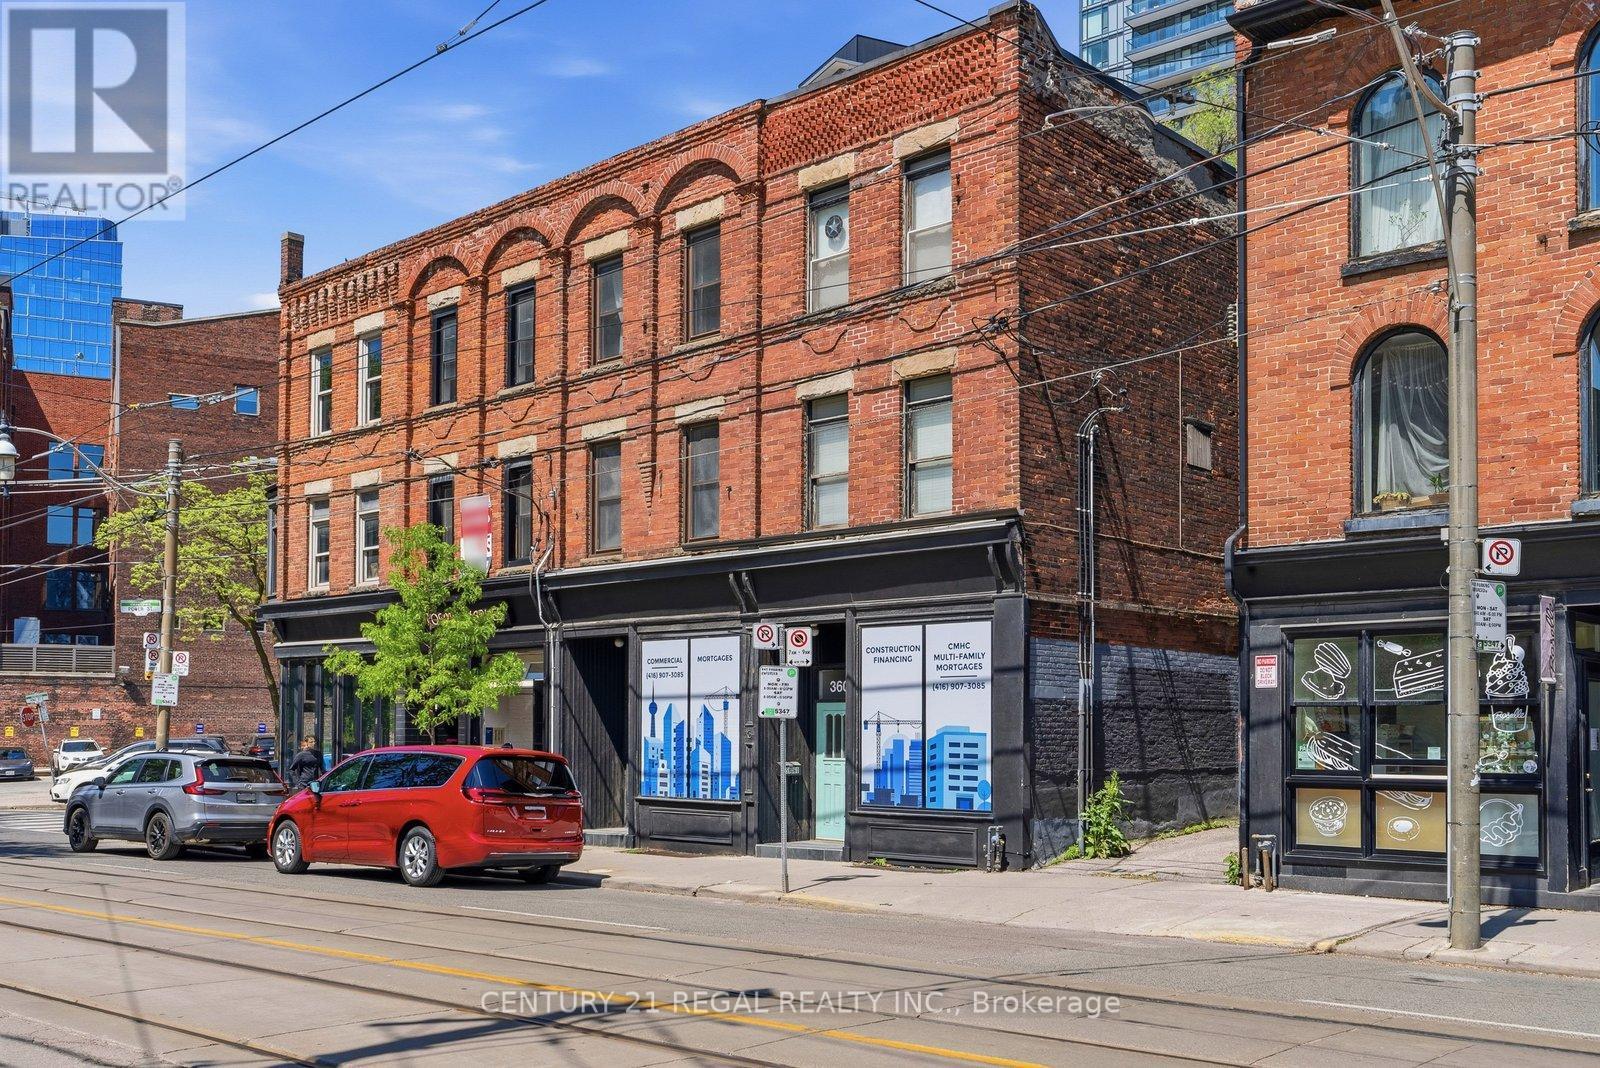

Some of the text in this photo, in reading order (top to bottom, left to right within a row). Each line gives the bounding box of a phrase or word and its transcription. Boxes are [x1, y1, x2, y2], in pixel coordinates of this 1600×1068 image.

[865, 644, 921, 654] CONSTRUCTION
[947, 642, 971, 650] CMHC
[646, 657, 683, 665] COMMERCIAL
[696, 654, 733, 662] MORTGAGES
[873, 655, 913, 664] FINANCING
[933, 652, 986, 661] MULTI-FAMILY
[935, 663, 983, 672] MORTGAGES
[646, 671, 684, 680] (416) 907-3085
[932, 682, 986, 692] (416) 907-3085
